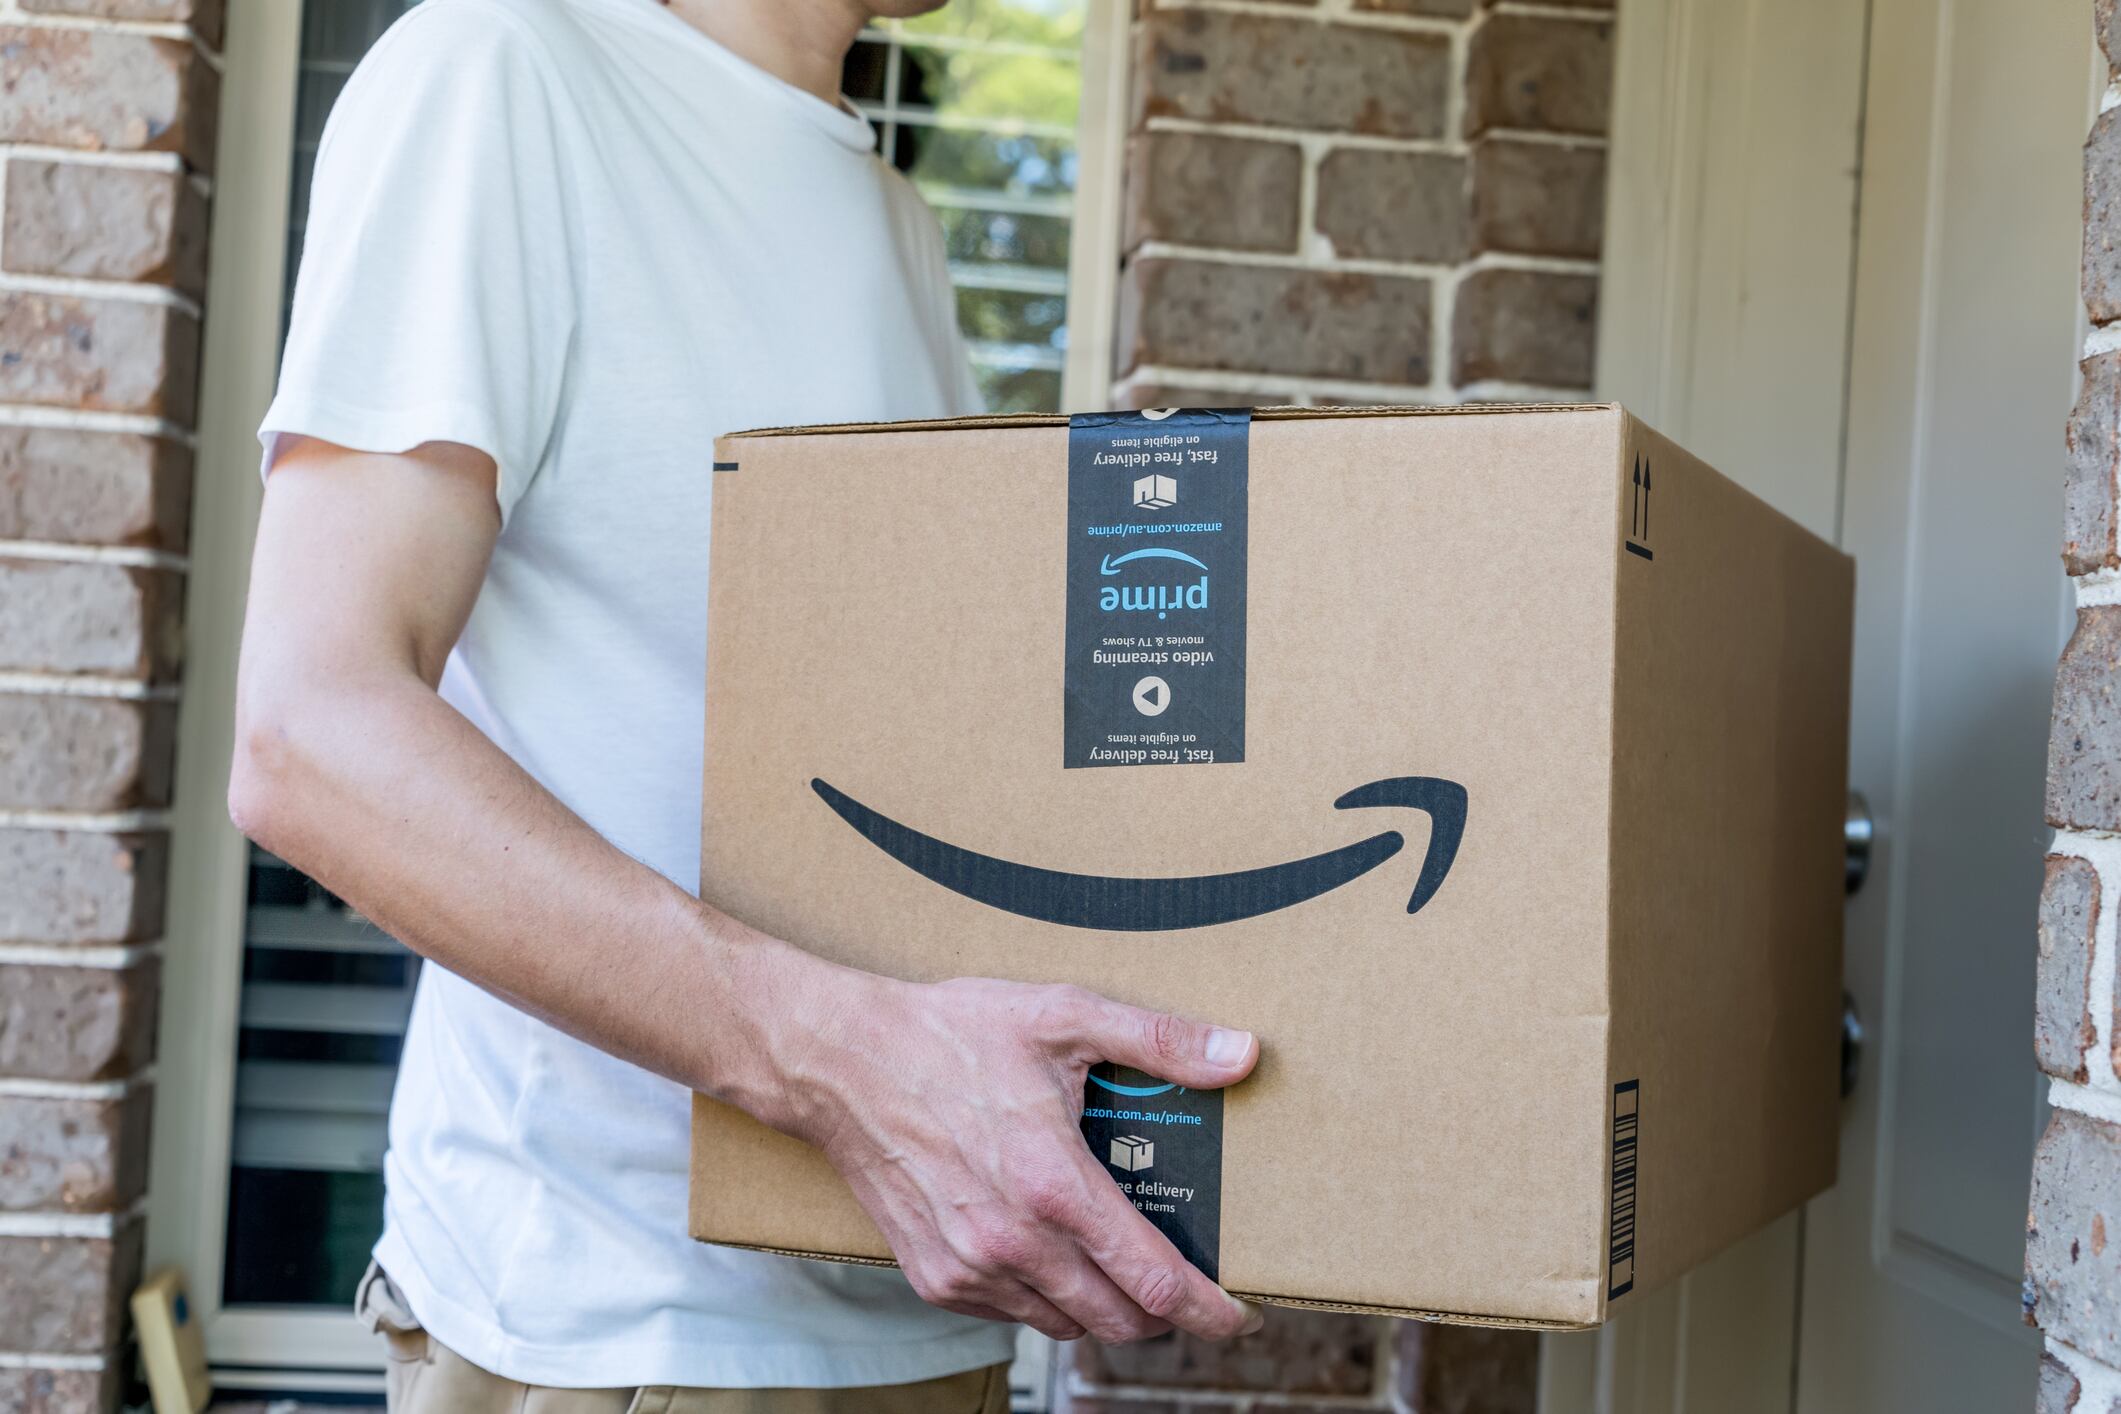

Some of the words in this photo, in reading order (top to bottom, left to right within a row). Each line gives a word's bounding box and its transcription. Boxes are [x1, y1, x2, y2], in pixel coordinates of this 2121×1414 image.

[1112, 439, 1140, 448] items
[1143, 436, 1183, 447] eligible
[1187, 436, 1200, 444] on
[1094, 452, 1150, 467] delivery
[1154, 452, 1183, 465] free
[1187, 450, 1218, 464] fast,
[1088, 522, 1222, 538] amazon.com.au/prime
[1100, 576, 1208, 619] prime
[1102, 637, 1135, 646] shows
[1138, 637, 1152, 646] TV
[1156, 637, 1163, 646] &
[1166, 636, 1204, 645] movies
[1093, 650, 1168, 667] streaming
[1173, 652, 1214, 666] video
[1108, 734, 1137, 745] items
[1140, 732, 1179, 744] eligible
[1182, 734, 1196, 742] on
[1089, 747, 1146, 763] delivery
[1150, 750, 1179, 763] free
[1183, 747, 1215, 763] fast,
[1082, 1107, 1201, 1125] azon.com.au/prime
[1136, 1181, 1194, 1202] delivery
[1145, 1200, 1176, 1213] items
